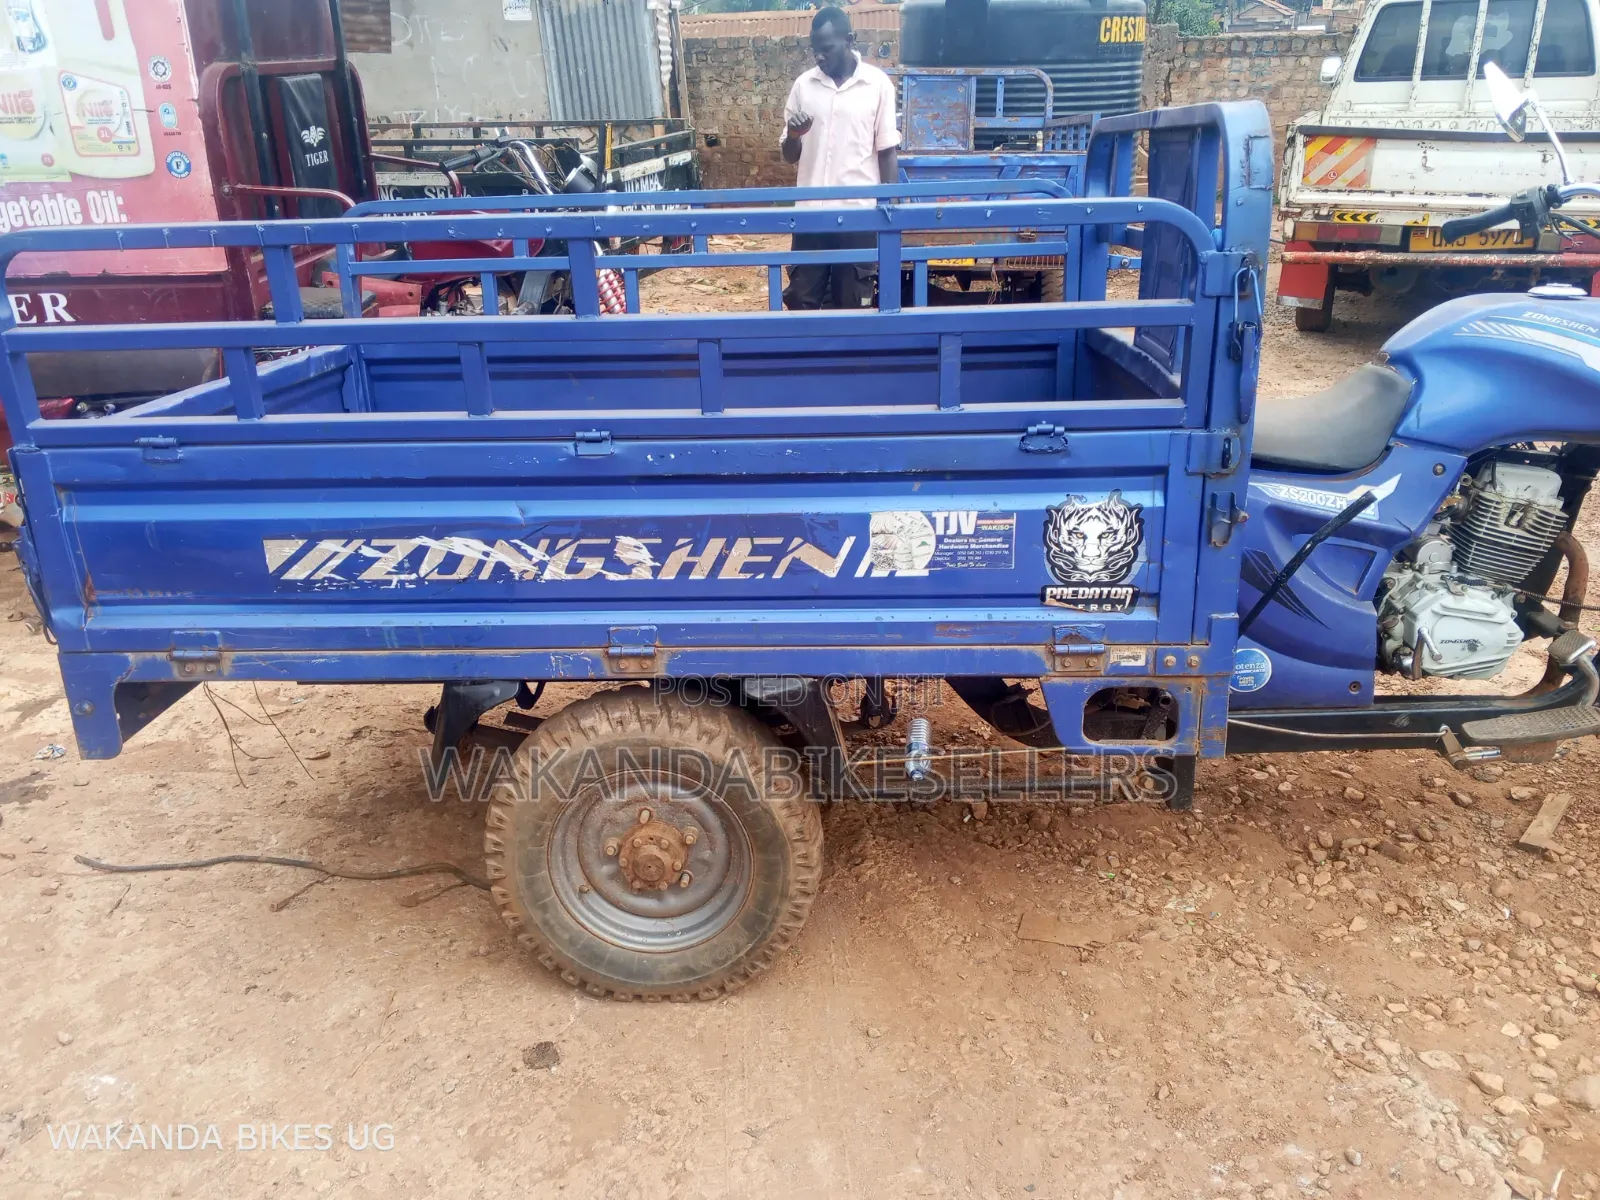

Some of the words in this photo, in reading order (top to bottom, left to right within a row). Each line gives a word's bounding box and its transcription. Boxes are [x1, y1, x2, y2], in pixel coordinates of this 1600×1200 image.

[305, 150, 329, 167] TIGER
[86, 190, 128, 224] Oil:
[1521, 311, 1599, 333] ZONGSHEN
[932, 511, 978, 535] TJV
[357, 535, 856, 582] ZONGSHEN
[1045, 587, 1134, 609] PREDATOR
